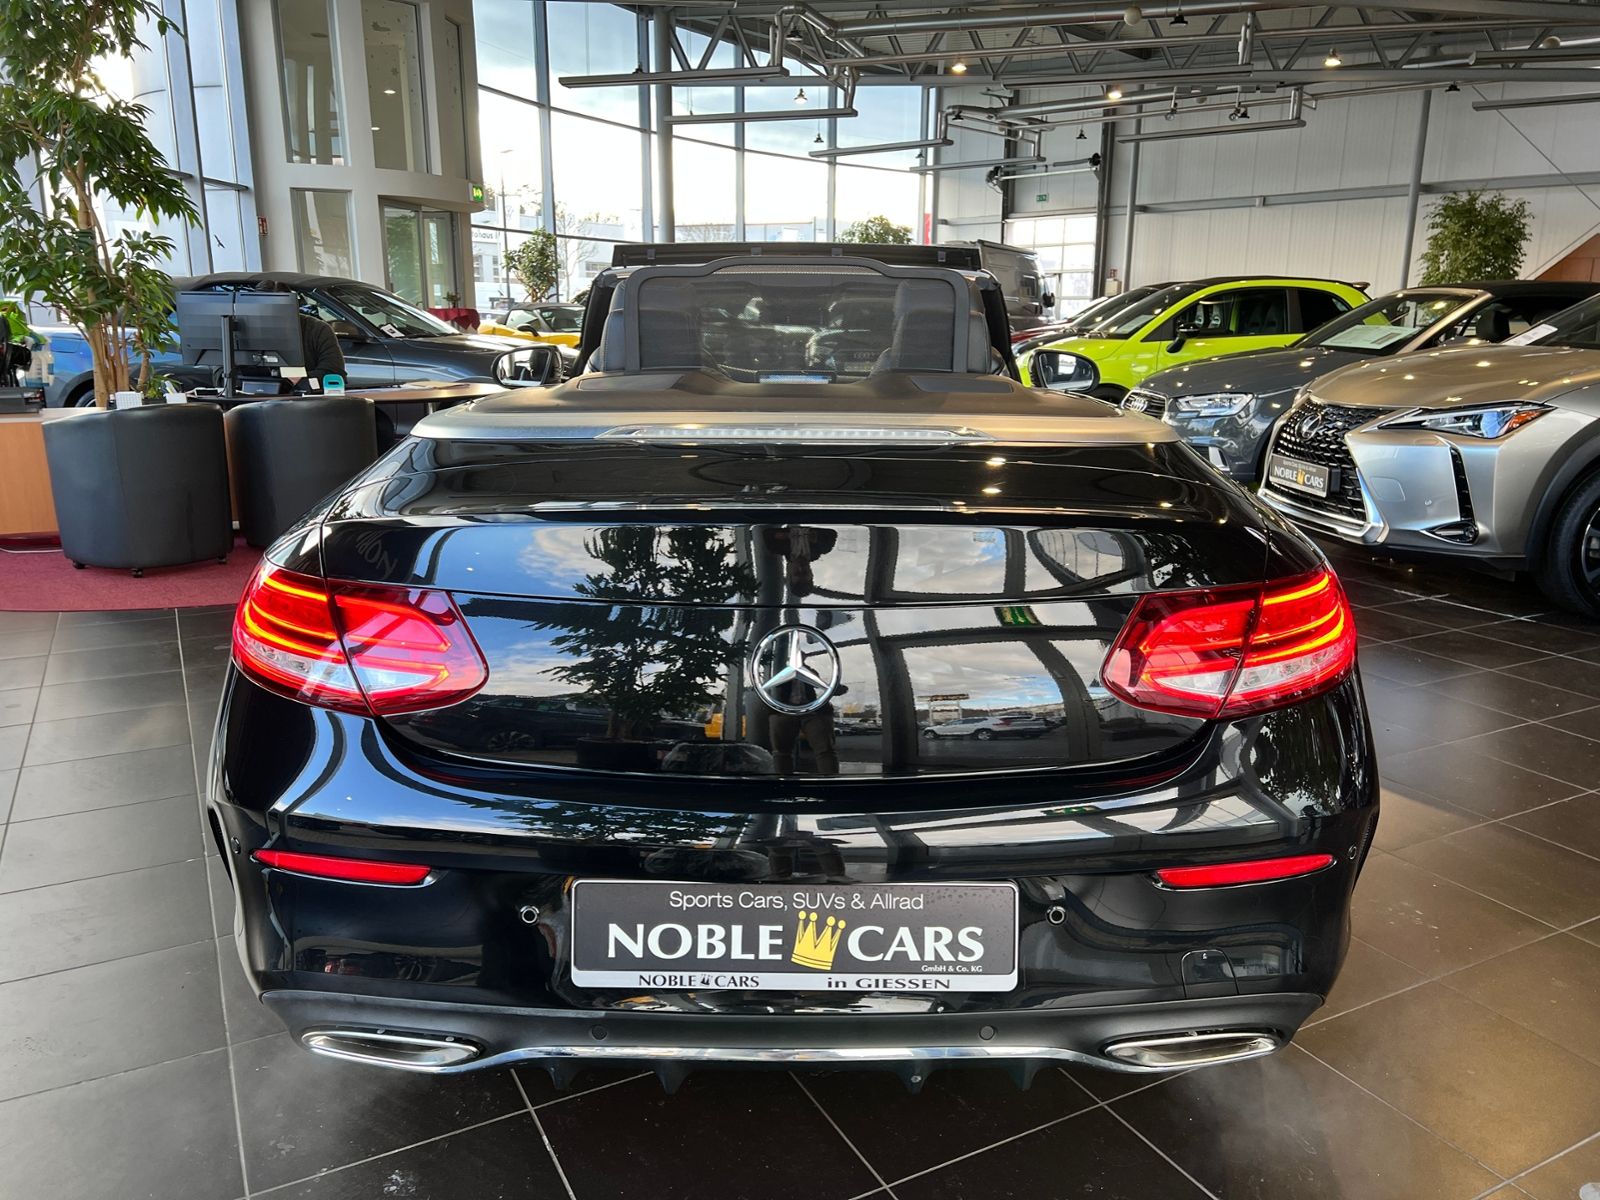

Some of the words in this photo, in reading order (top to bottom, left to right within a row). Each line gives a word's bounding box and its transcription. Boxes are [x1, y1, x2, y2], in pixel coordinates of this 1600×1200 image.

[1274, 465, 1298, 481] NOBLE
[1304, 473, 1324, 488] CARS
[669, 890, 733, 911] Sports
[738, 891, 788, 911] Cars,
[792, 892, 846, 910] SUVs
[851, 893, 866, 910] &
[870, 893, 924, 910] Allrad
[607, 922, 784, 960] NOBLE
[847, 925, 985, 962] CARS
[921, 964, 947, 972] GmbH
[638, 974, 697, 987] NOBLE
[714, 975, 760, 988] CARS
[827, 977, 847, 989] in
[855, 978, 950, 989] GIESSEN
